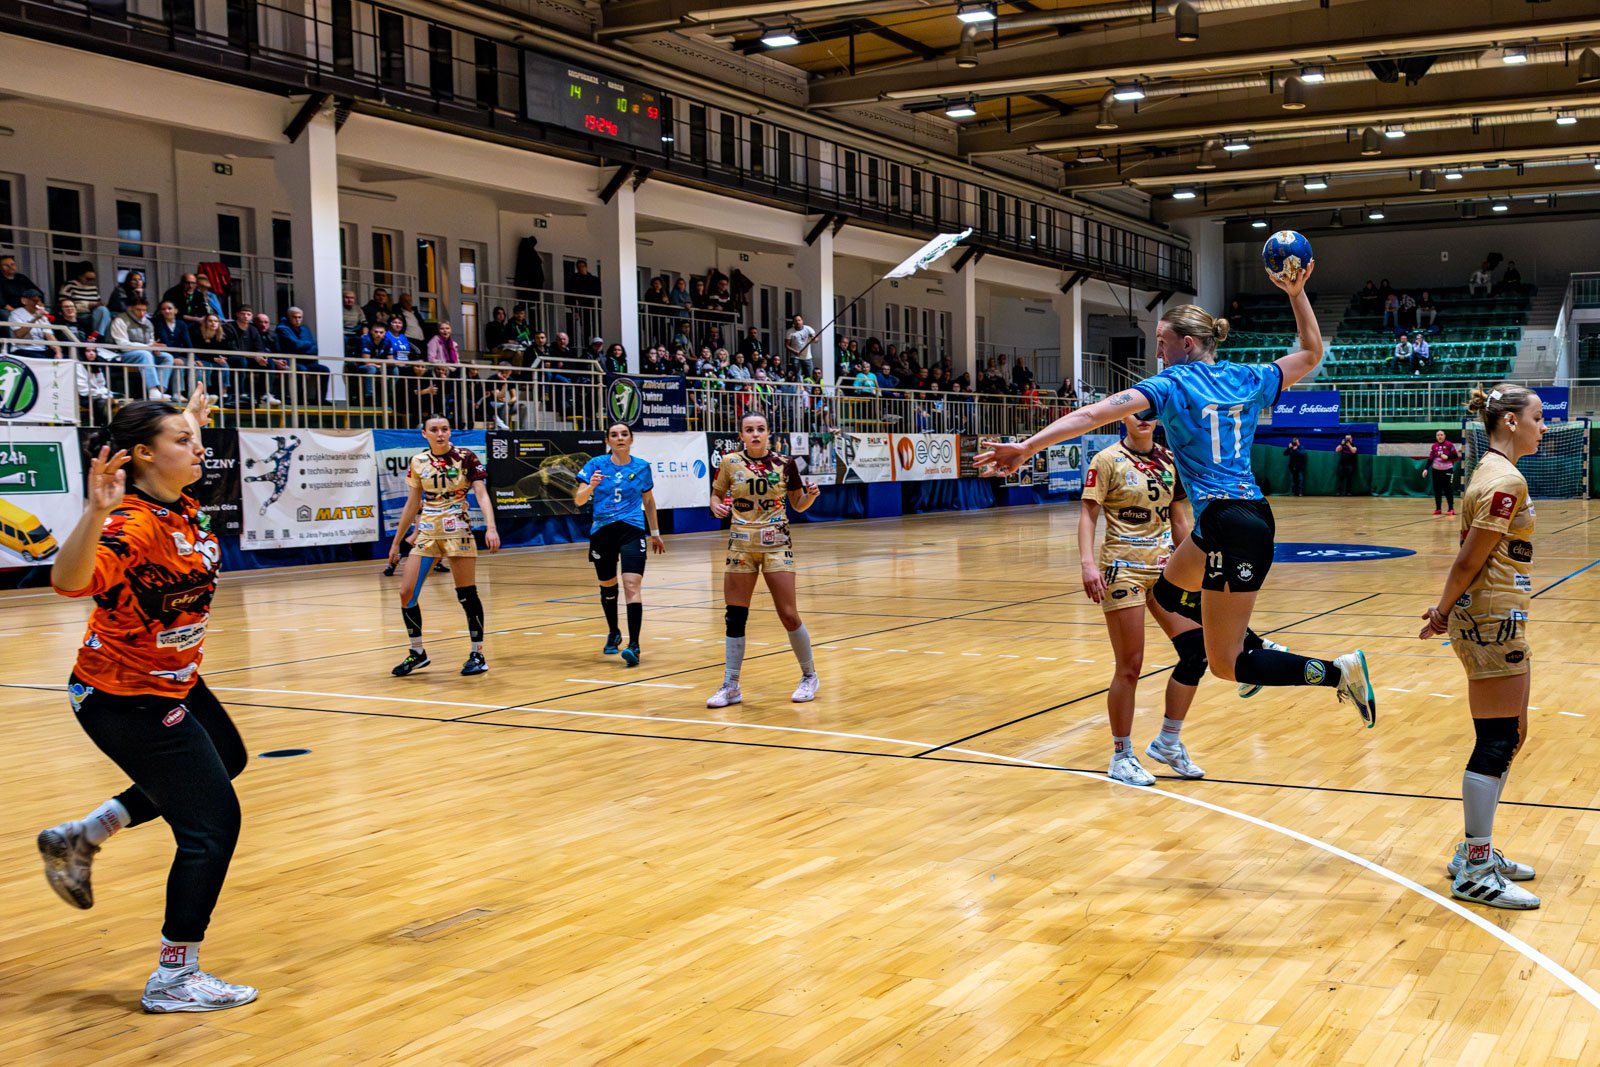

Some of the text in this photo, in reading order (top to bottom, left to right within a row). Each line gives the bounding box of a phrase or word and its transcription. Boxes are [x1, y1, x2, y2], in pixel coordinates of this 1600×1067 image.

[570, 84, 582, 99] 14
[617, 97, 628, 113] 10
[648, 106, 659, 119] 53
[643, 404, 687, 414] by Jelenia Góra
[1273, 404, 1297, 414] Hotel
[1201, 404, 1245, 464] 11
[0, 450, 27, 465] 24h
[205, 447, 214, 457] G
[915, 439, 953, 465] eco
[205, 459, 235, 469] CZNY
[307, 467, 333, 475] technika
[657, 461, 688, 473] ECH
[940, 465, 952, 474] Góra
[430, 473, 447, 489] 11
[746, 478, 768, 496] 10
[613, 487, 623, 503] 5
[1147, 479, 1160, 501] 5
[221, 503, 238, 511] Góra
[314, 505, 374, 521] MATEX
[1122, 509, 1148, 519] elmas
[1208, 550, 1223, 569] 11
